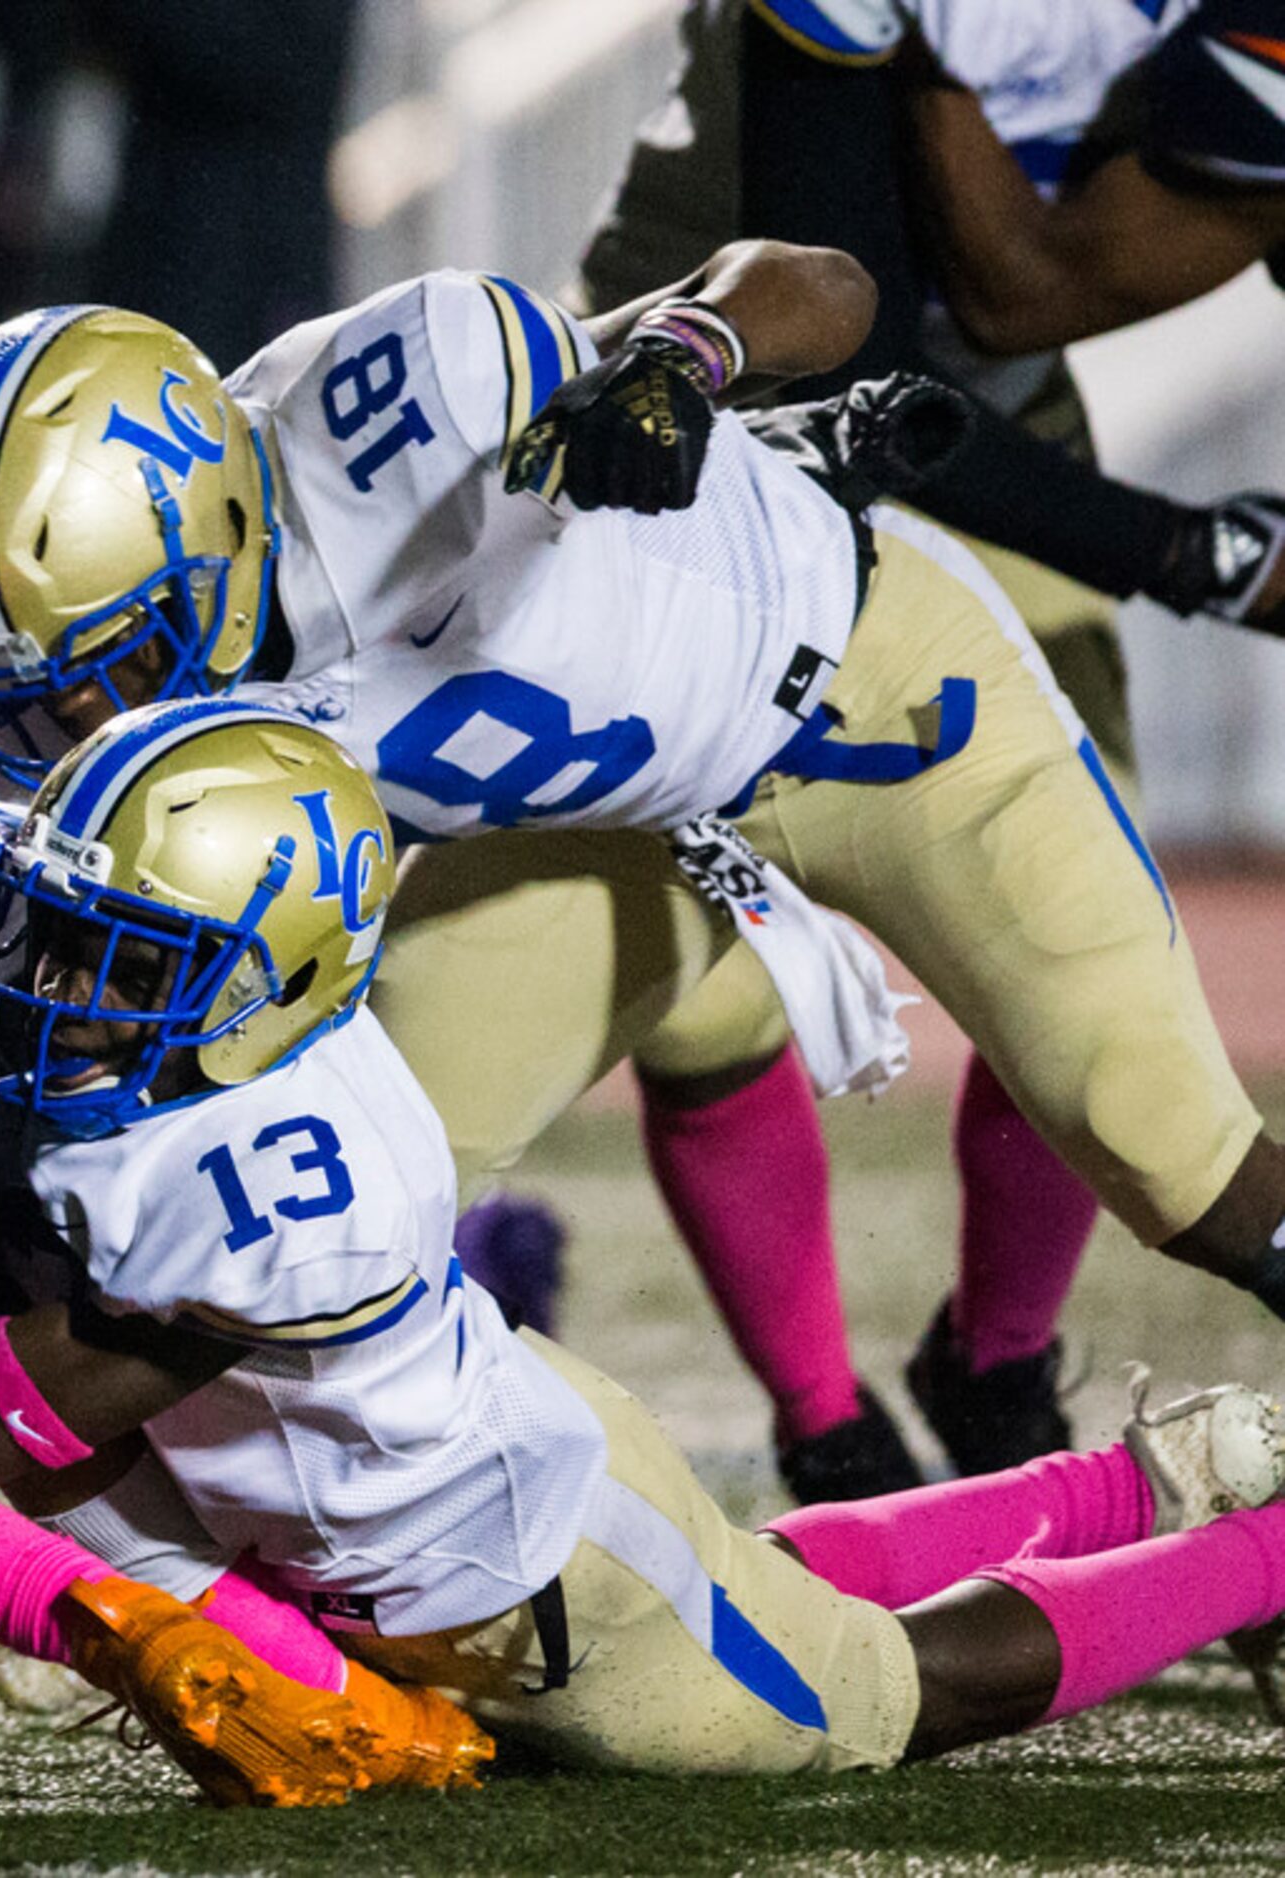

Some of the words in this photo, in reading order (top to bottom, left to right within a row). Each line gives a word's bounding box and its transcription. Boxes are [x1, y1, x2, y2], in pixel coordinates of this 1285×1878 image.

[320, 331, 437, 493] 18
[787, 672, 810, 690] L
[196, 1114, 356, 1254] 13
